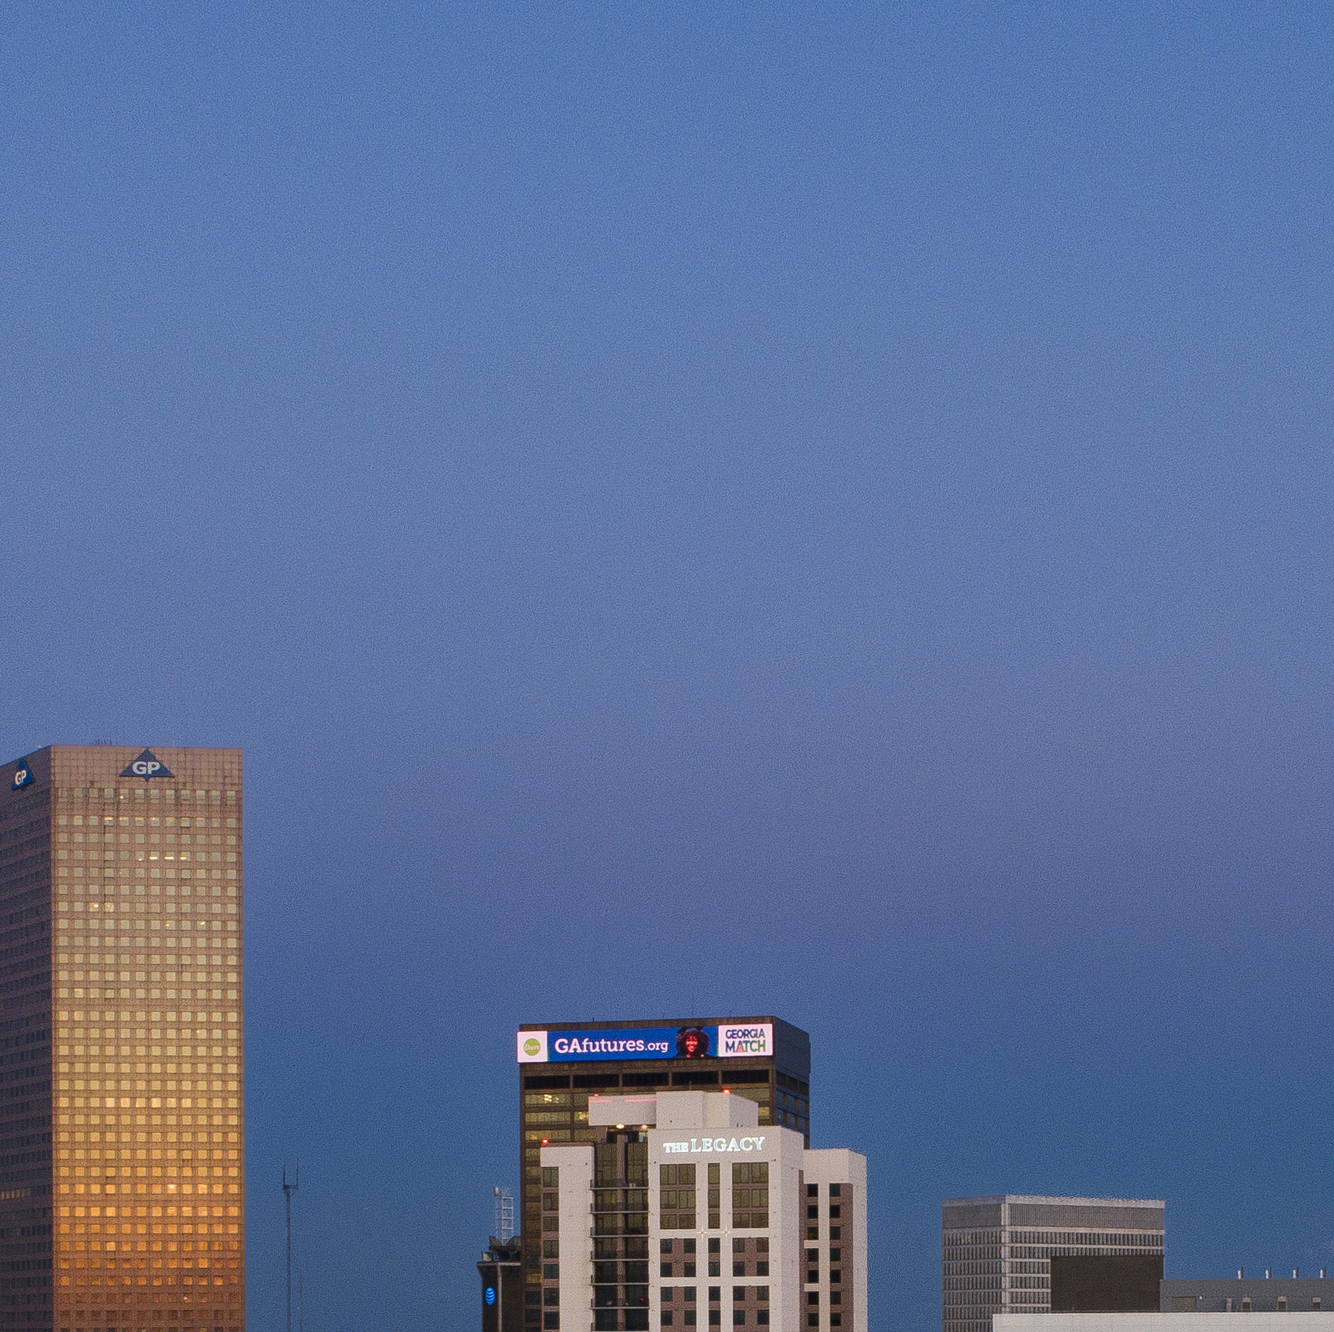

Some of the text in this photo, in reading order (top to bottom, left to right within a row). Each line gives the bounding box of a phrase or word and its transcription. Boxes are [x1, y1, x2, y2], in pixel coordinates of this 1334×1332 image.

[132, 761, 160, 775] GP
[15, 769, 27, 785] GP
[725, 1028, 766, 1039] GEORGIA
[554, 1037, 669, 1054] GAfutures.org
[725, 1039, 766, 1053] MATCH
[663, 1136, 766, 1153] THE LEGACY
